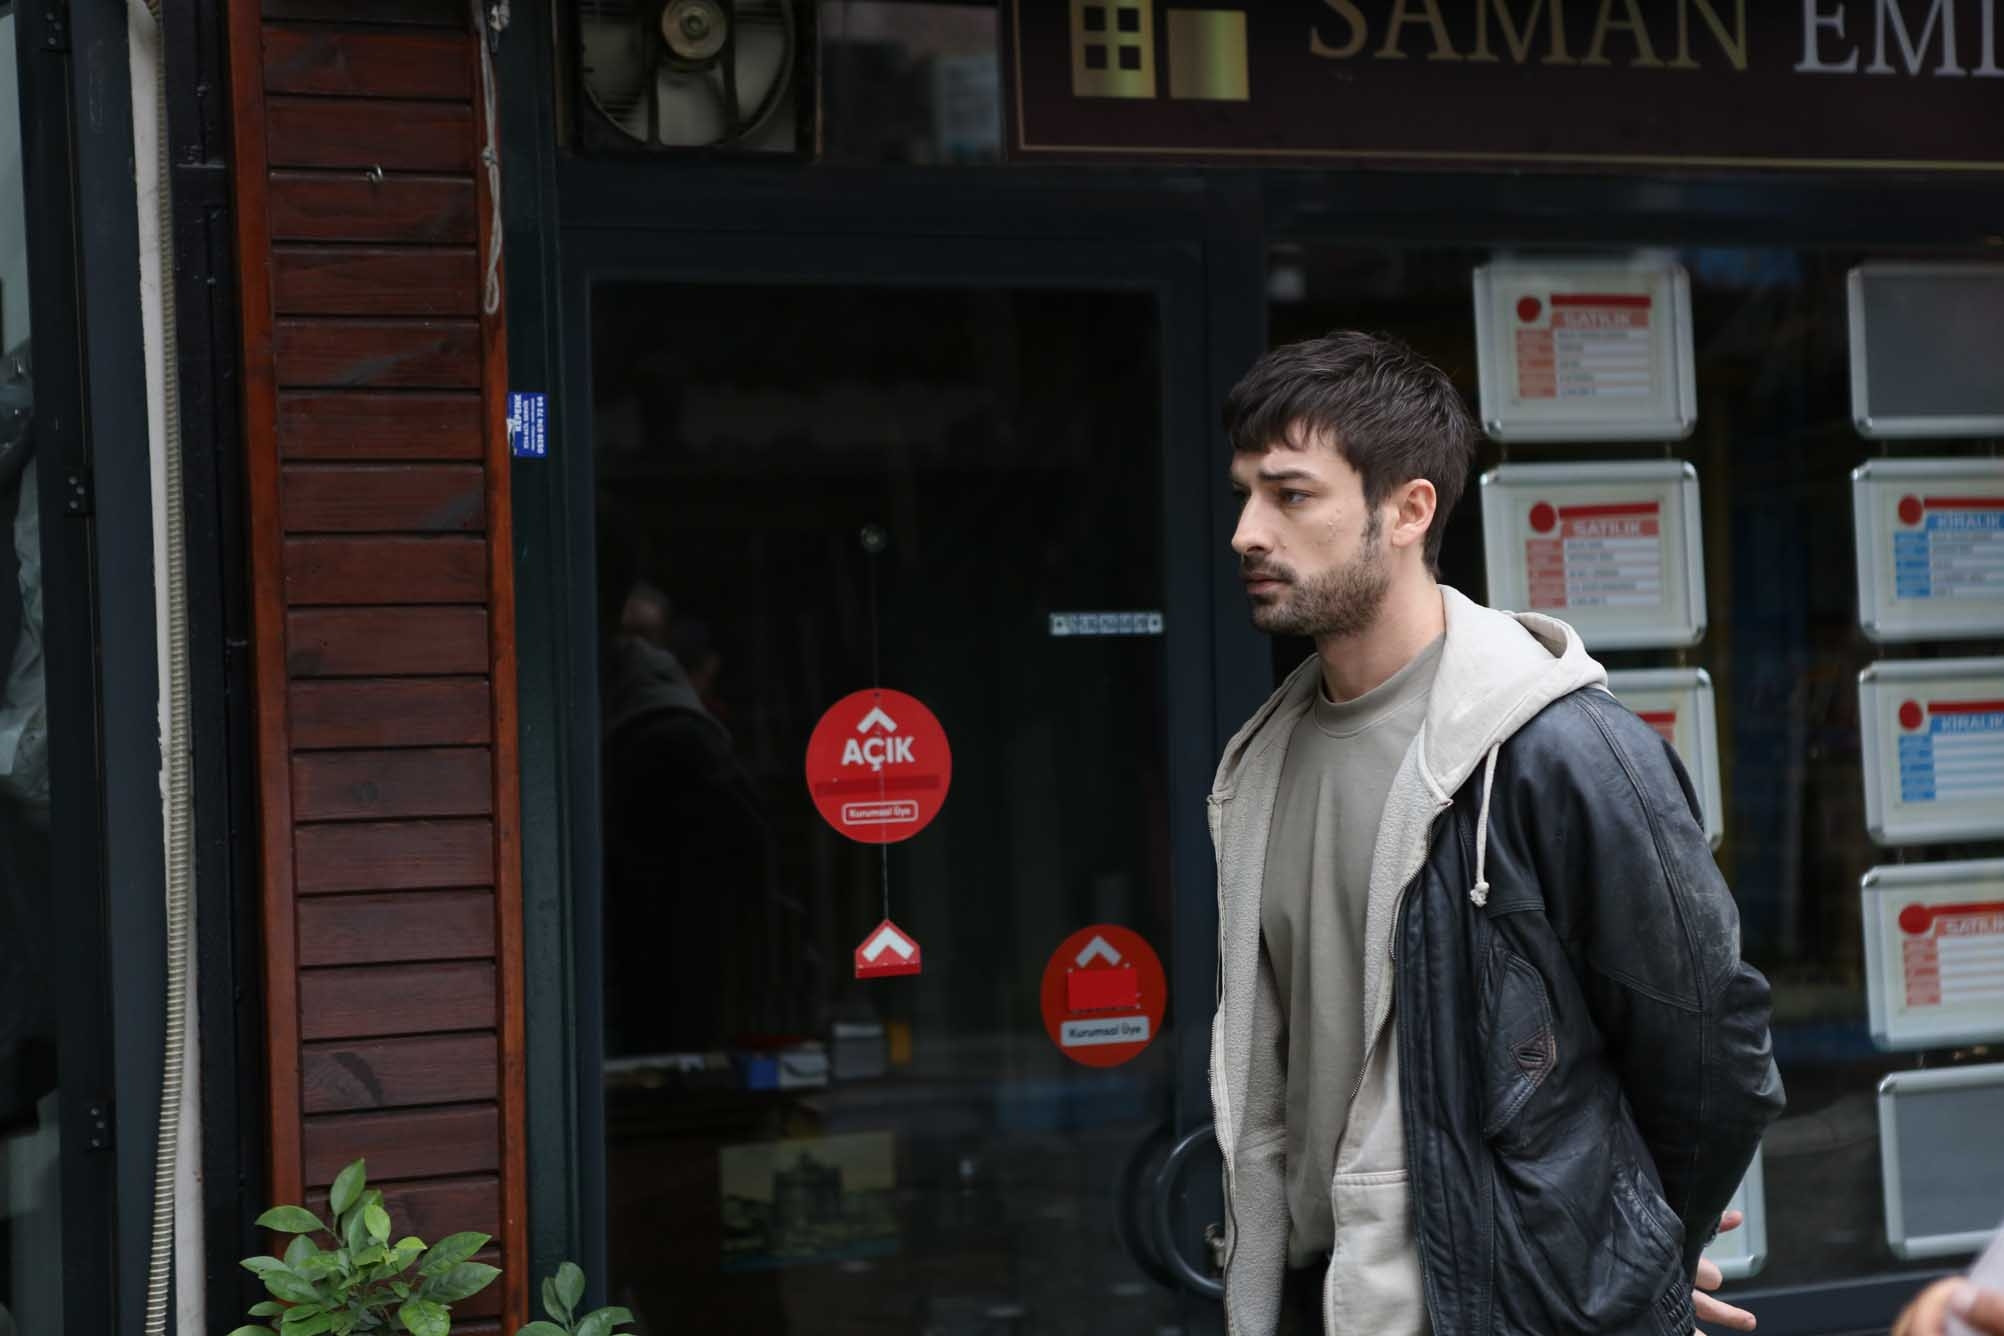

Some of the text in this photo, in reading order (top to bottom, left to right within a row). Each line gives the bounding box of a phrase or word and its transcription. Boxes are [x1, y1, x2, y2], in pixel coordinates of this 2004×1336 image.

[1309, 0, 1748, 71] SAMAN
[841, 736, 915, 771] AÇIK
[848, 807, 892, 819] Kurumsal
[1068, 1022, 1141, 1039] Kurumsal Üye
